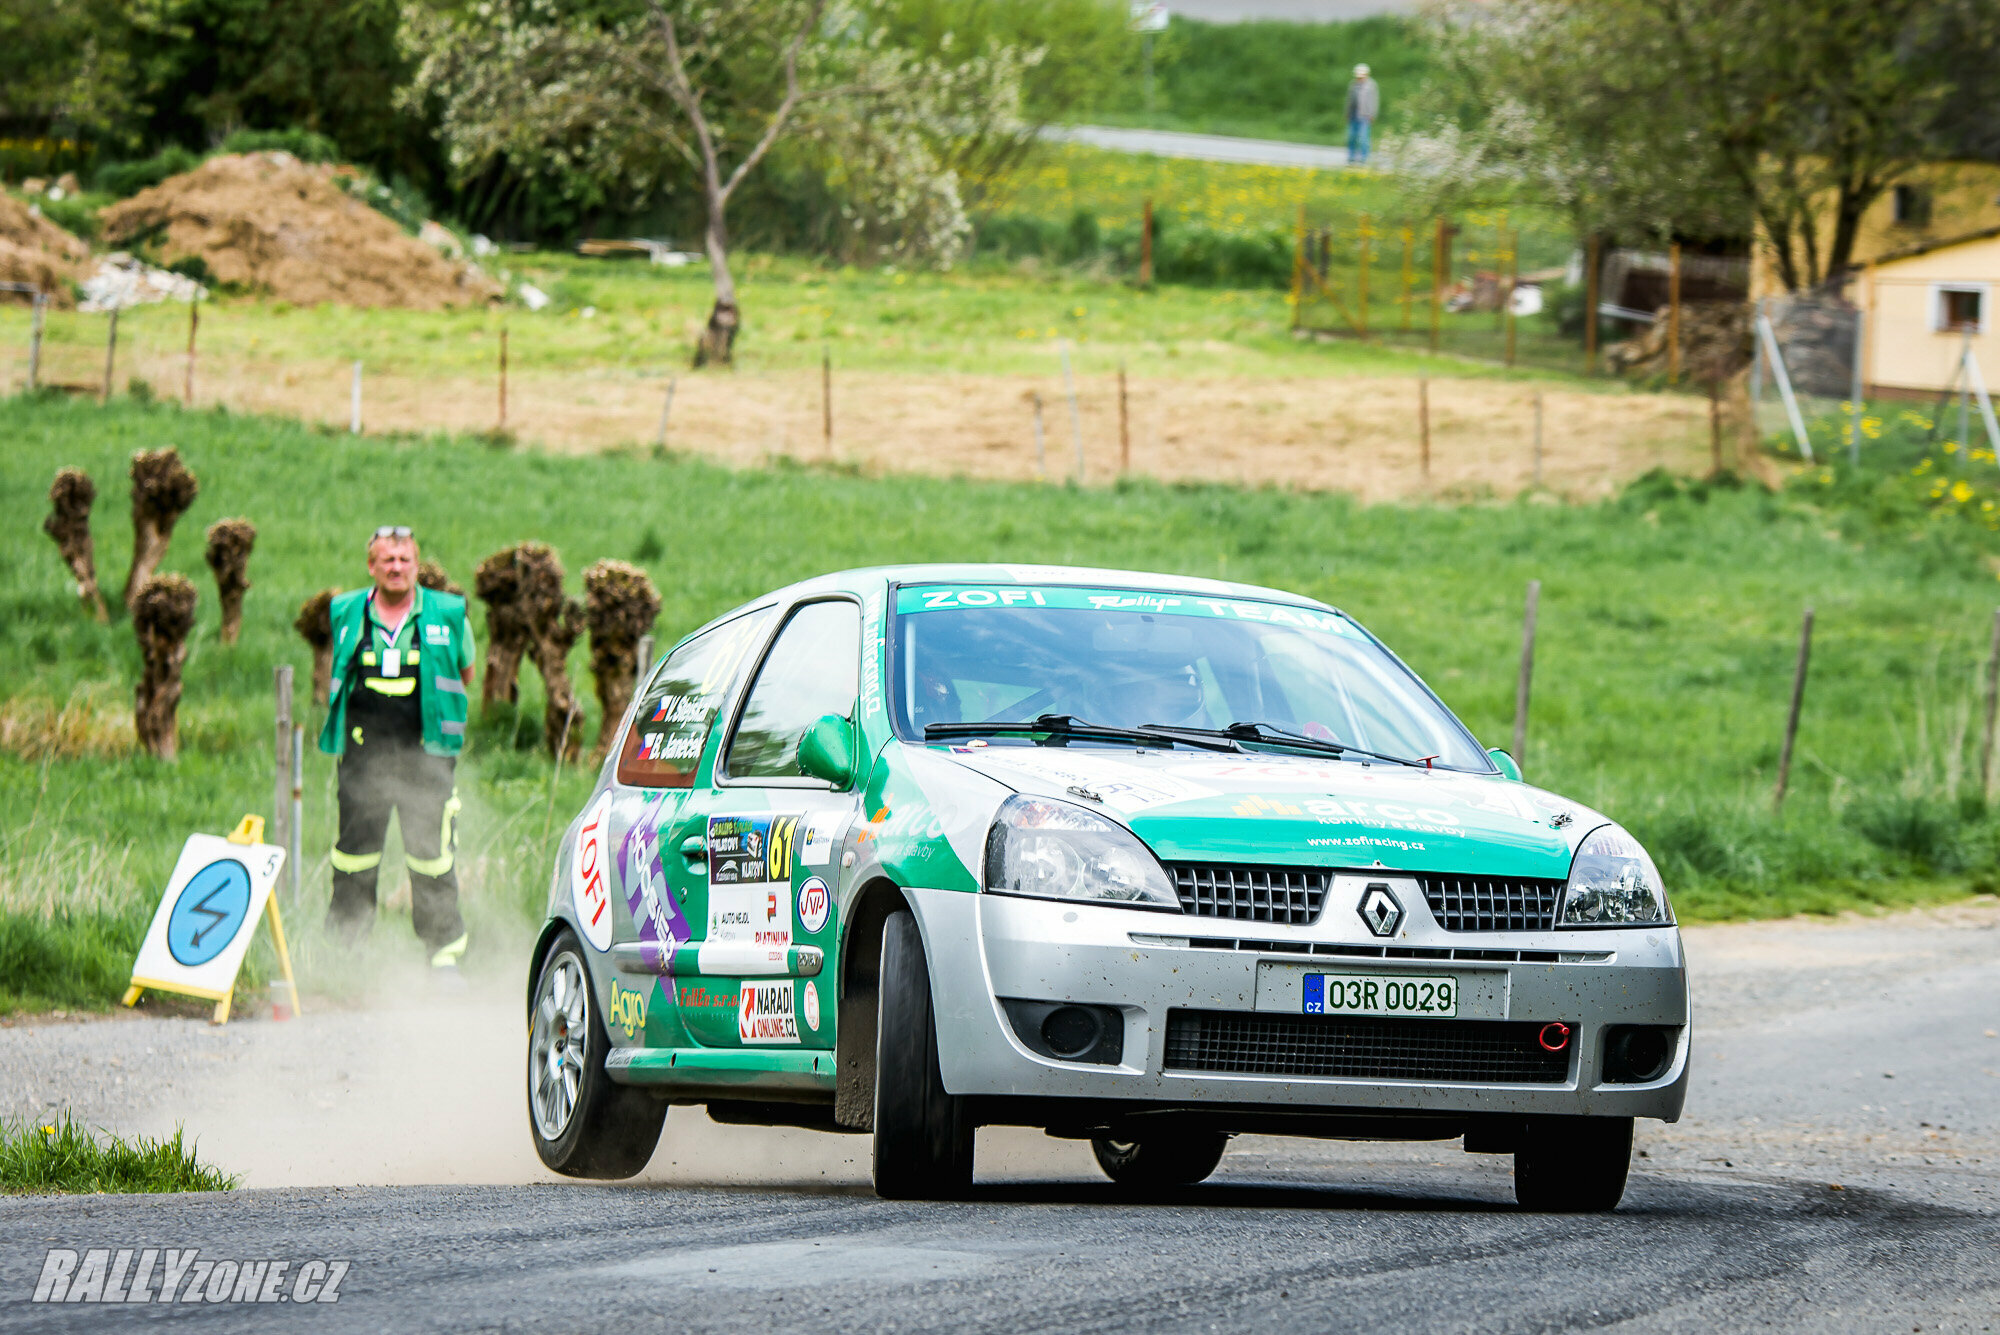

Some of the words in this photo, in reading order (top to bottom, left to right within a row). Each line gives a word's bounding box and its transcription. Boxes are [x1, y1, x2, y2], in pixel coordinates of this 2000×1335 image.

[922, 590, 1046, 608] ZOFI
[1197, 600, 1344, 634] TEAM
[769, 816, 799, 880] 61
[1306, 835, 1426, 851] www.zofiracing.cz
[262, 853, 279, 877] 5
[610, 977, 646, 1039] Agro
[1306, 1002, 1322, 1013] CZ
[1329, 981, 1379, 1010] 03R
[1385, 982, 1452, 1011] 0029
[757, 1017, 797, 1038] ONLINE.CZ
